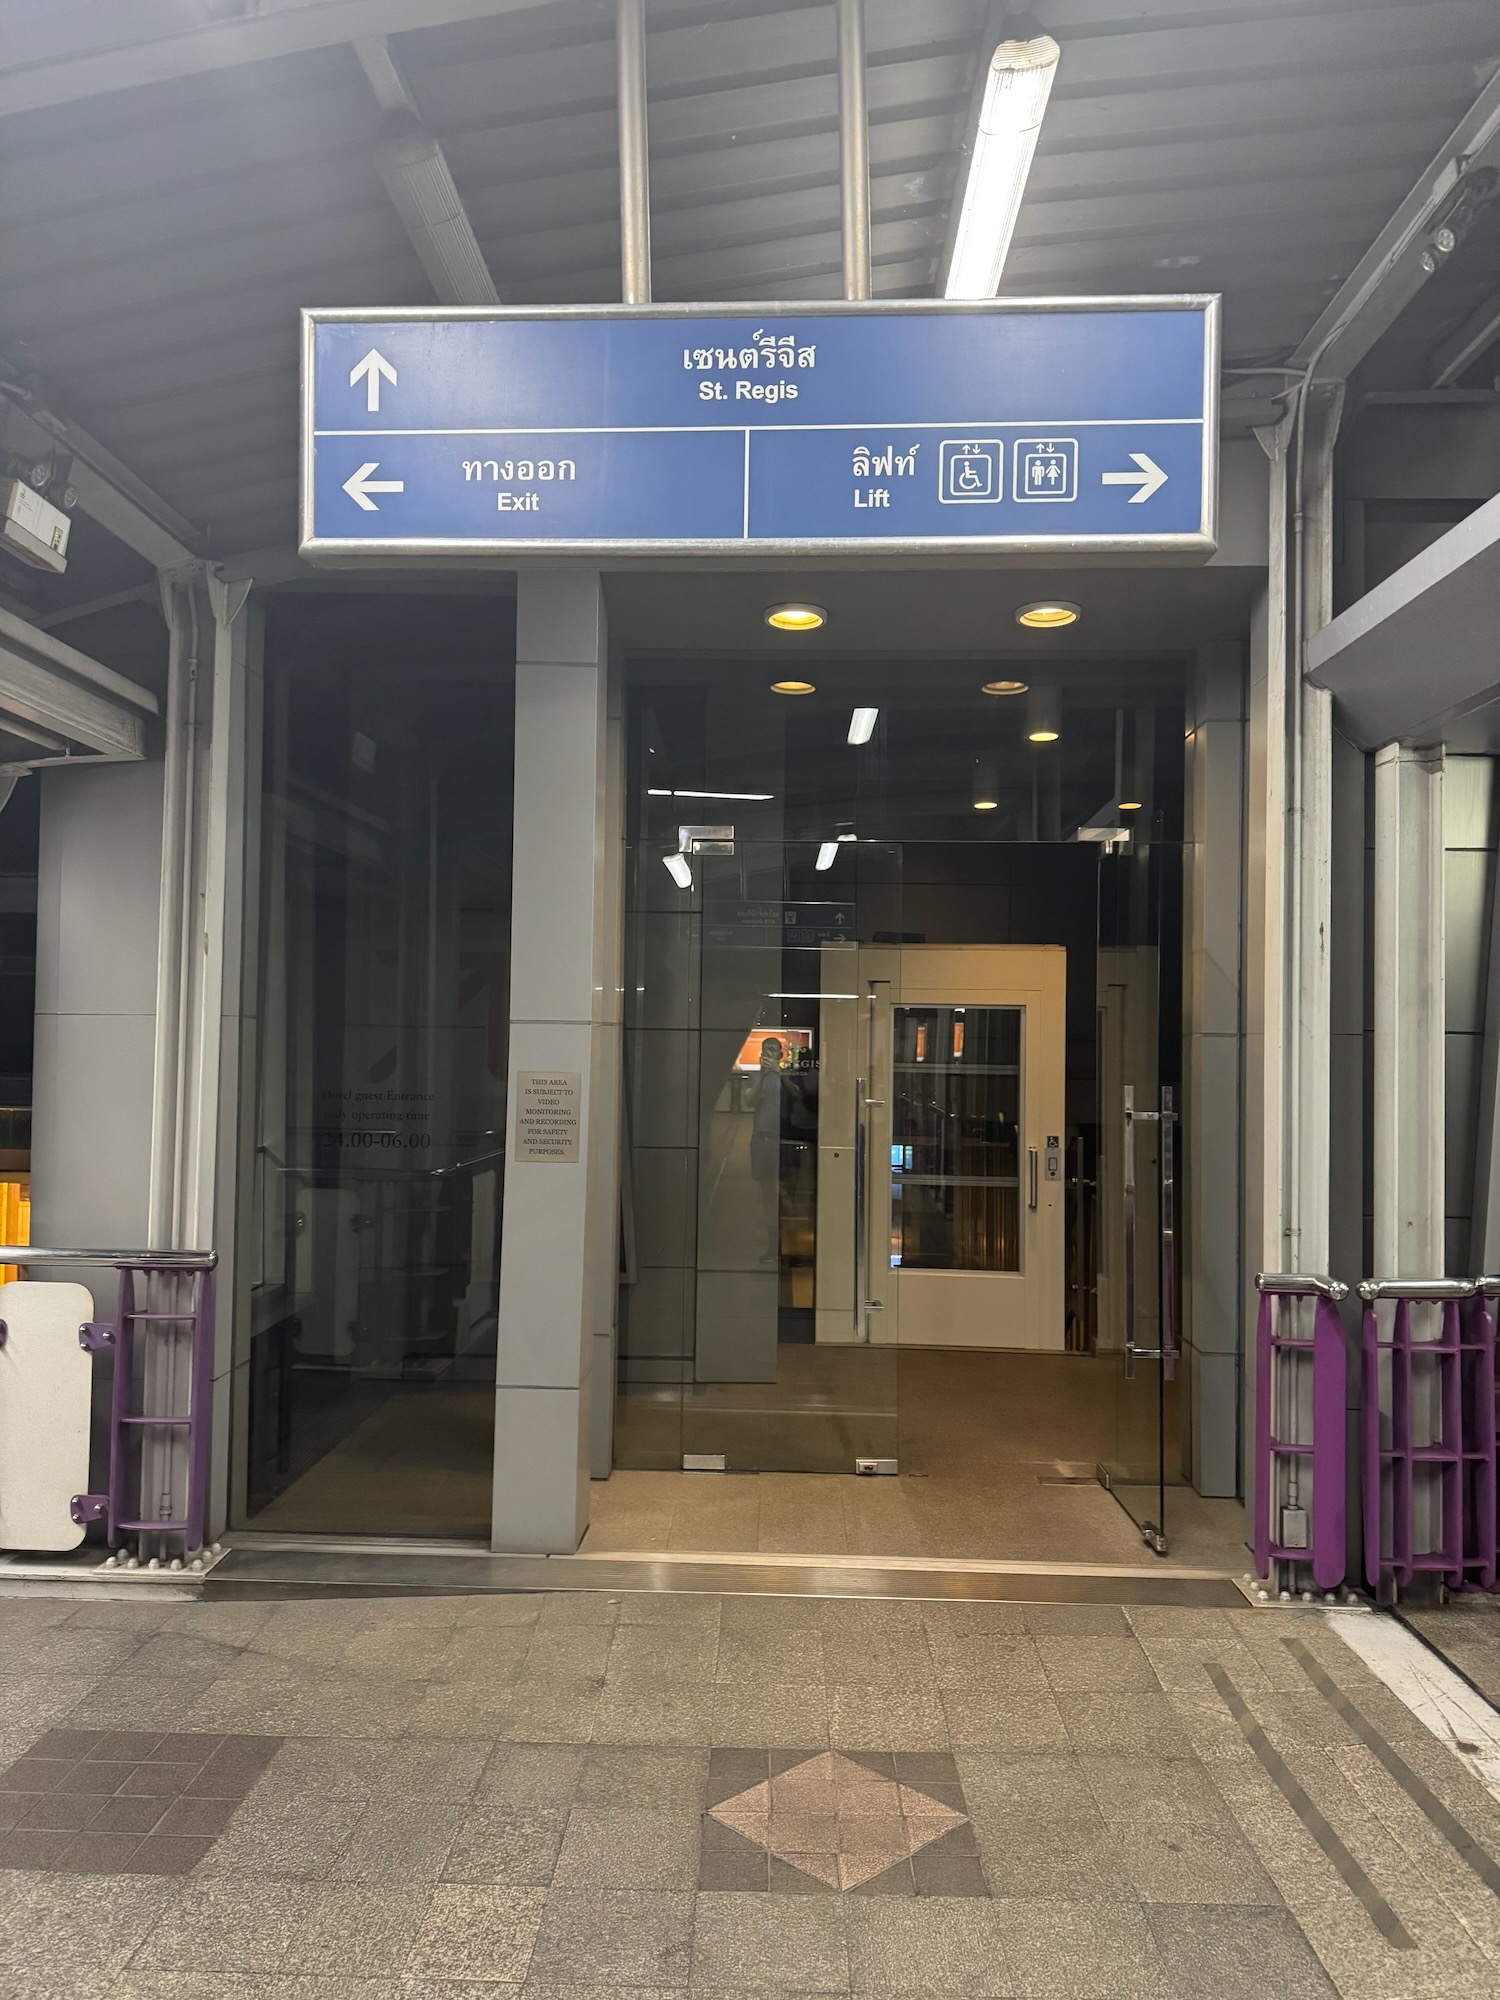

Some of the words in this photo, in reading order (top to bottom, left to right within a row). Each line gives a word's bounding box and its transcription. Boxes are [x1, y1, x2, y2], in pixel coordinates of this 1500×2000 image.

[683, 328, 816, 370] เซนต์รีจีส
[698, 380, 728, 400] St.
[736, 380, 799, 404] Regis
[852, 444, 920, 477] ลิฟท์
[461, 460, 576, 481] ทางออก
[497, 492, 539, 511] Exit
[854, 489, 890, 508] Lift
[322, 1090, 352, 1100] Hotel
[355, 1092, 383, 1101] guest
[387, 1090, 434, 1101] Entrance
[352, 1110, 403, 1122] operating
[406, 1111, 430, 1120] time
[322, 1132, 431, 1148] 24.00-06.00
